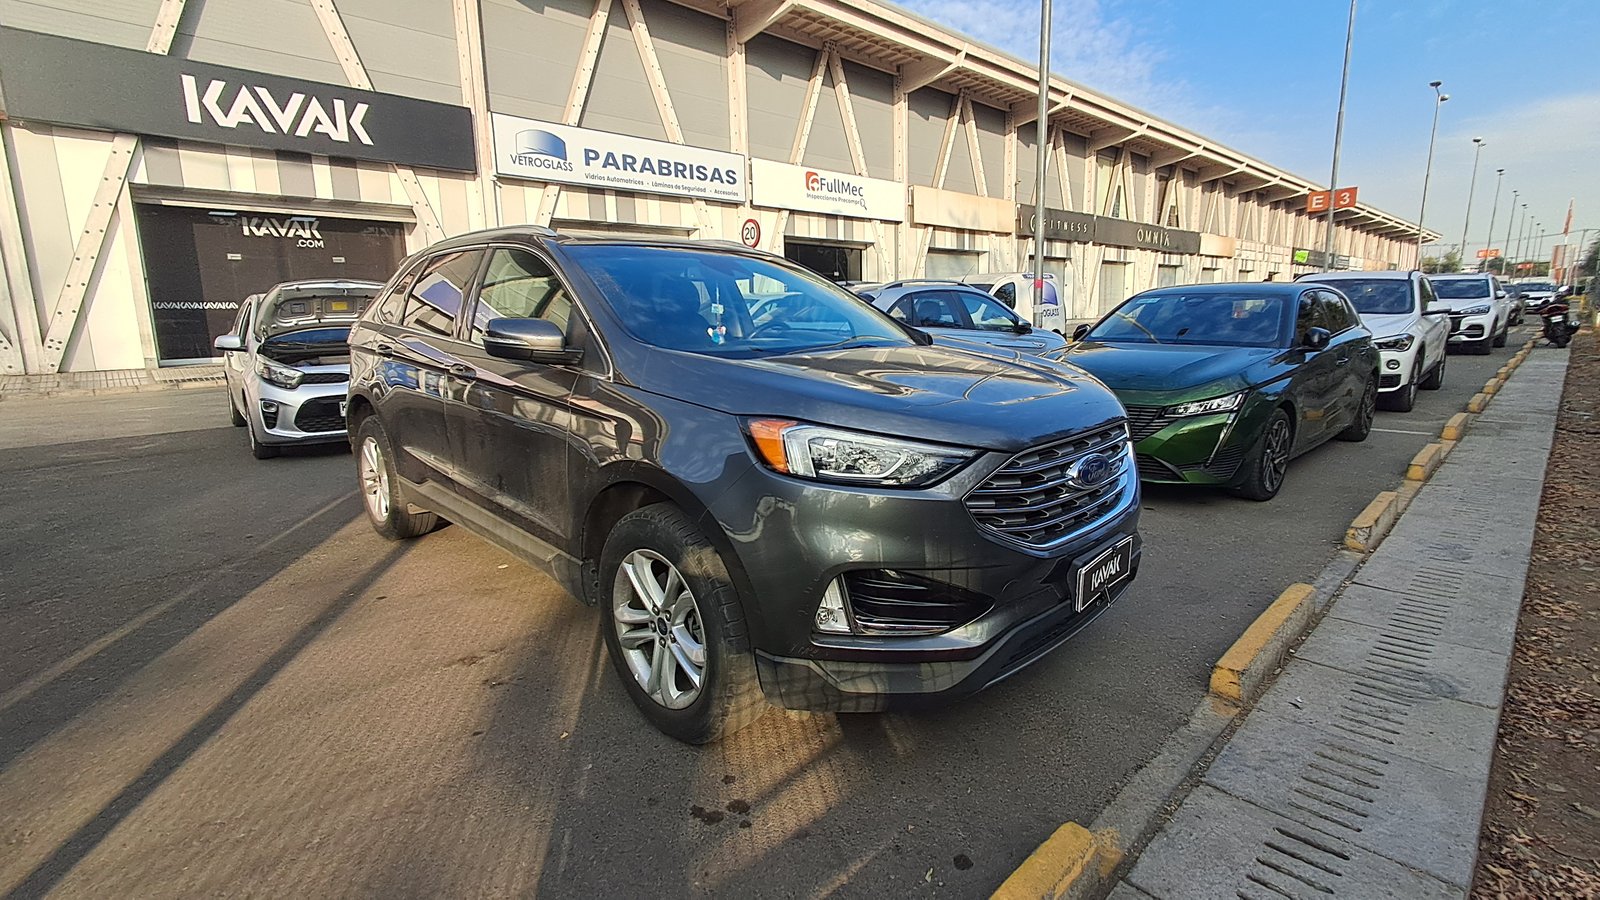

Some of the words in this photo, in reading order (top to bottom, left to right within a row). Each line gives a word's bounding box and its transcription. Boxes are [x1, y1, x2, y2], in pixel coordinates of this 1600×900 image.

[180, 73, 375, 146] KAVAK
[510, 154, 574, 172] VETROGLASS
[583, 148, 738, 185] PARABRISAS
[584, 172, 606, 181] Vidrios
[606, 175, 645, 186] Automotrices
[681, 185, 707, 193] Seguridad
[713, 188, 739, 197] Accesorios
[820, 177, 864, 197] FullMec
[1311, 195, 1325, 209] E
[1339, 191, 1350, 205] 3
[241, 216, 323, 240] KAVAK
[744, 226, 756, 240] 20
[296, 239, 325, 249] .COM
[1090, 553, 1122, 592] KAVAK
